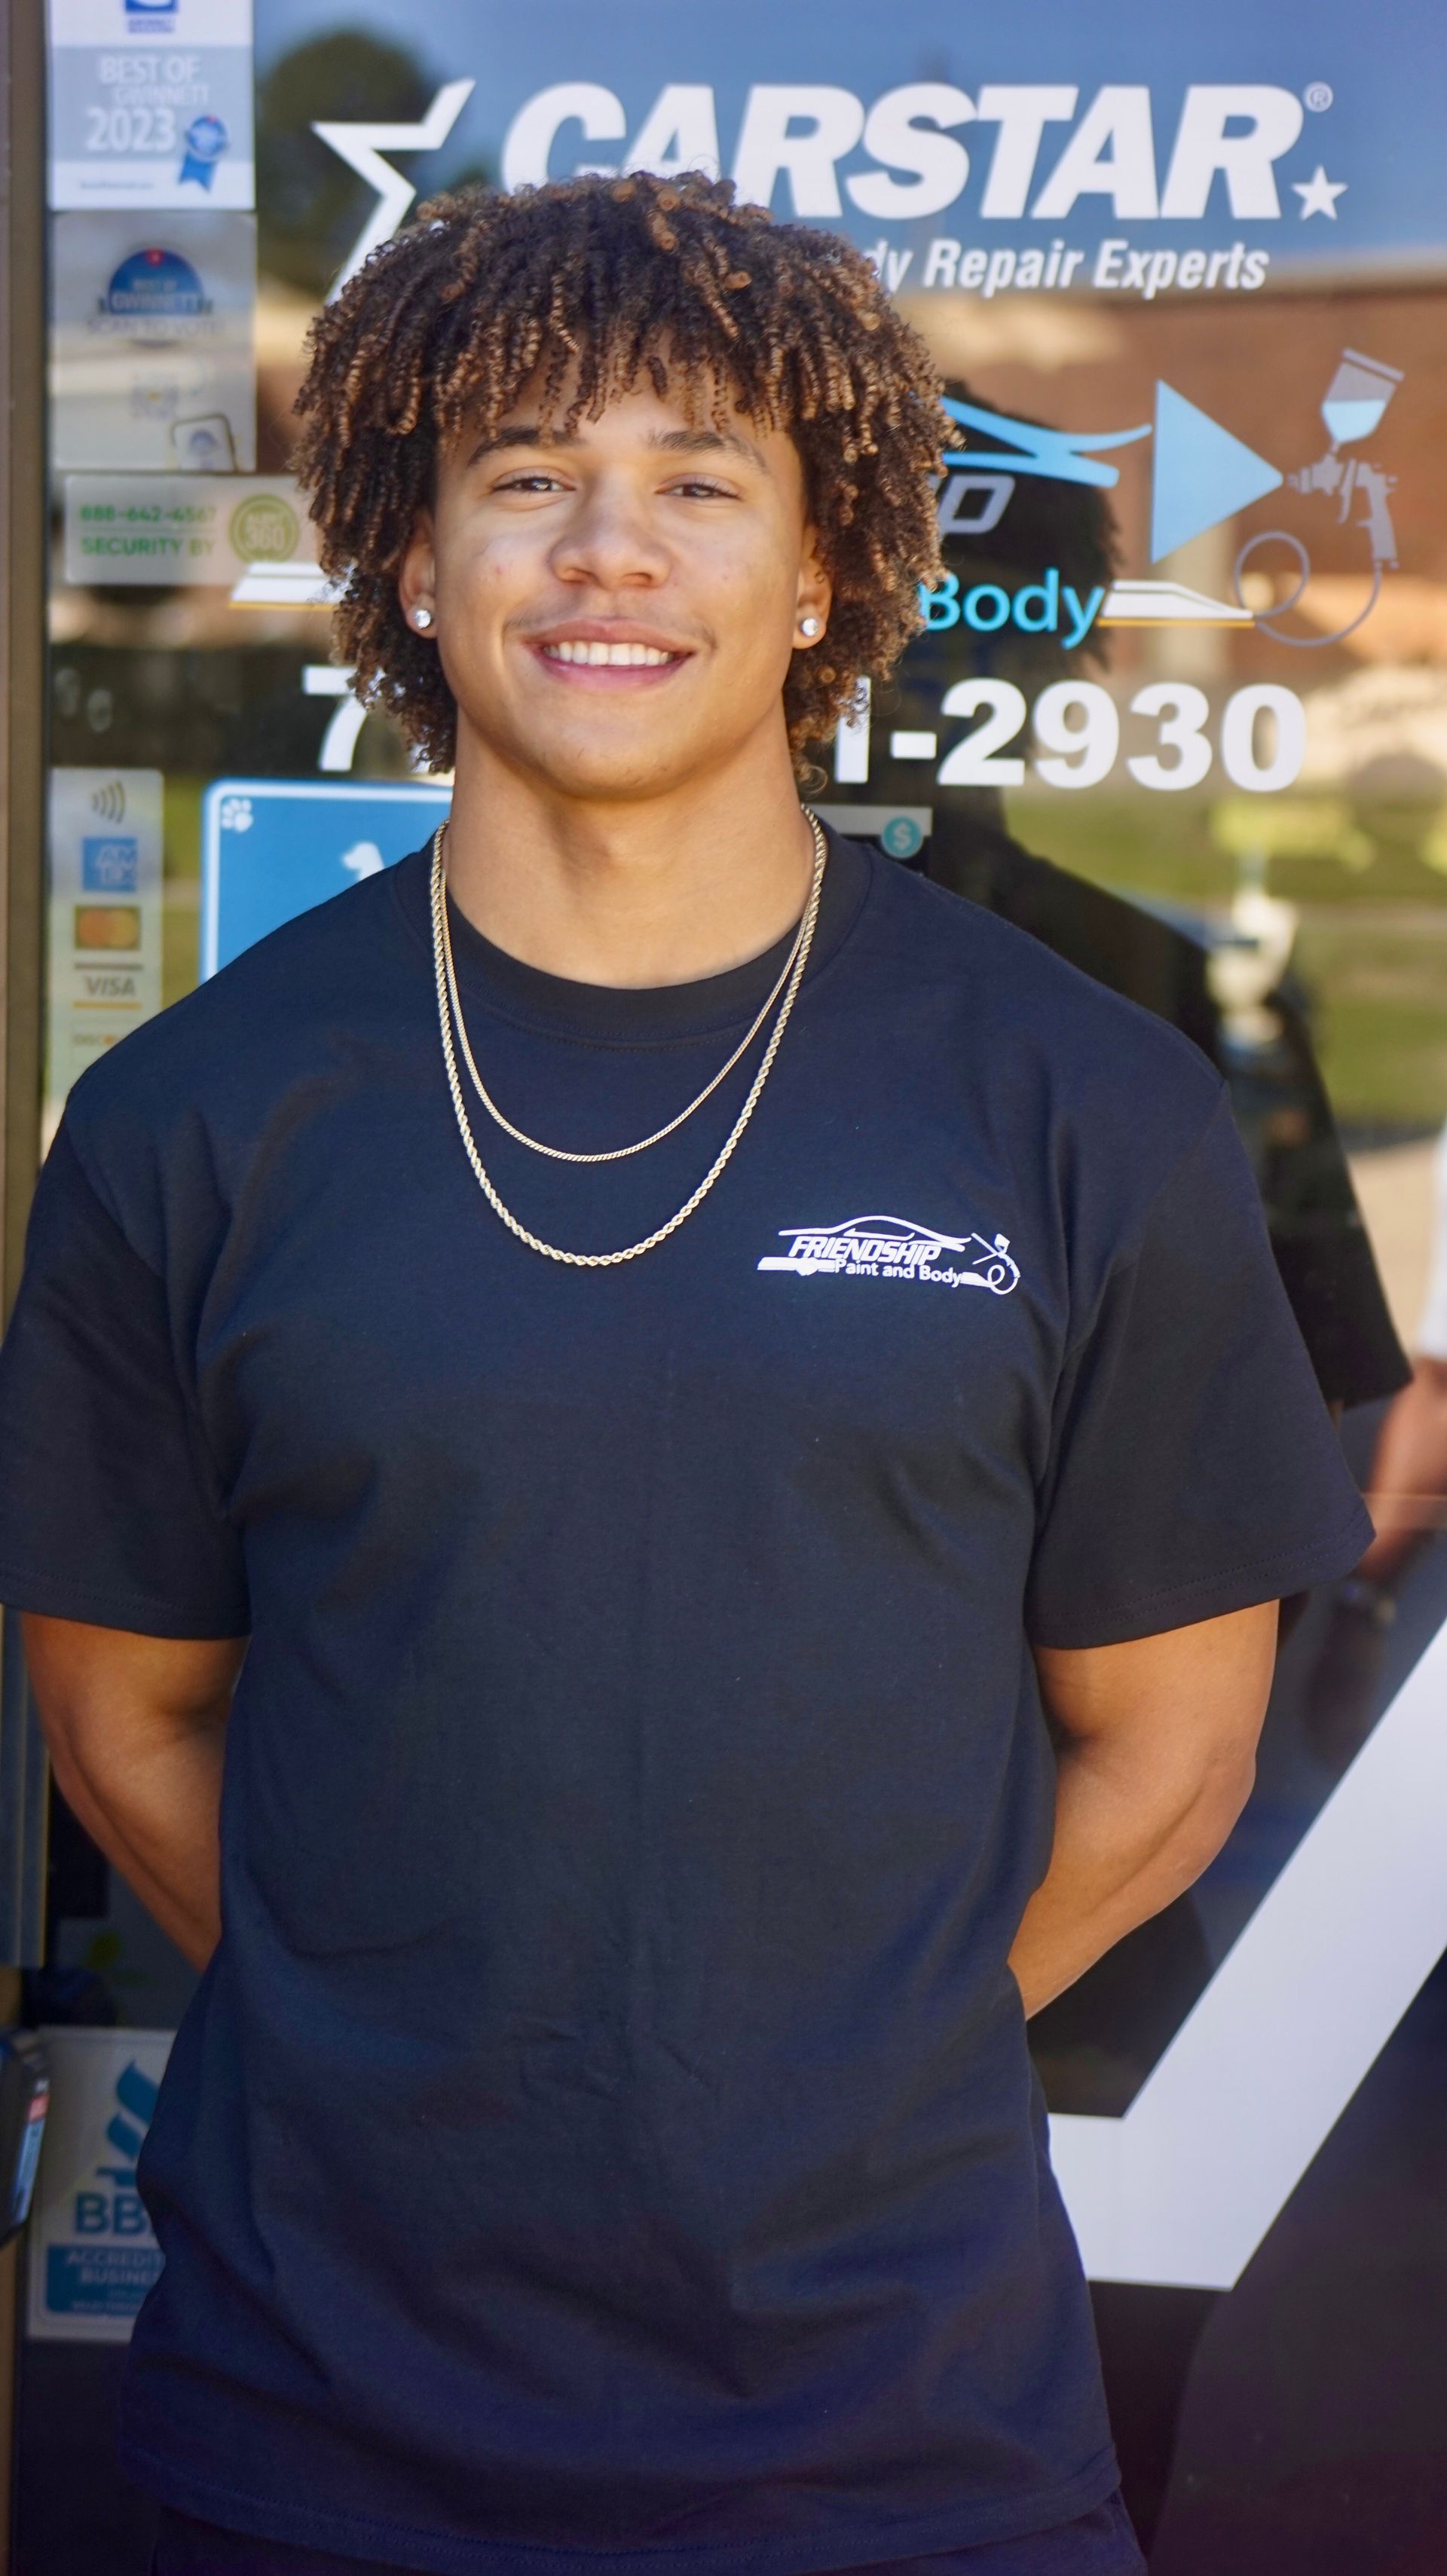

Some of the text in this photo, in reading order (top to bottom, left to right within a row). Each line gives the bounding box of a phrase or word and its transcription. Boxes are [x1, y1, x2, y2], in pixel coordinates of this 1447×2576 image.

[100, 55, 202, 83] BEST OF
[85, 106, 178, 152] 2023
[500, 82, 1304, 220] CARSTAR
[922, 239, 1084, 298] Repair
[1093, 240, 1271, 300] Experts
[81, 536, 217, 557] SECURITY BY
[917, 567, 1106, 650] Body
[84, 976, 136, 996] VISA
[788, 1236, 942, 1266] FRIENDSHIP
[835, 1257, 962, 1288] Paint and Body
